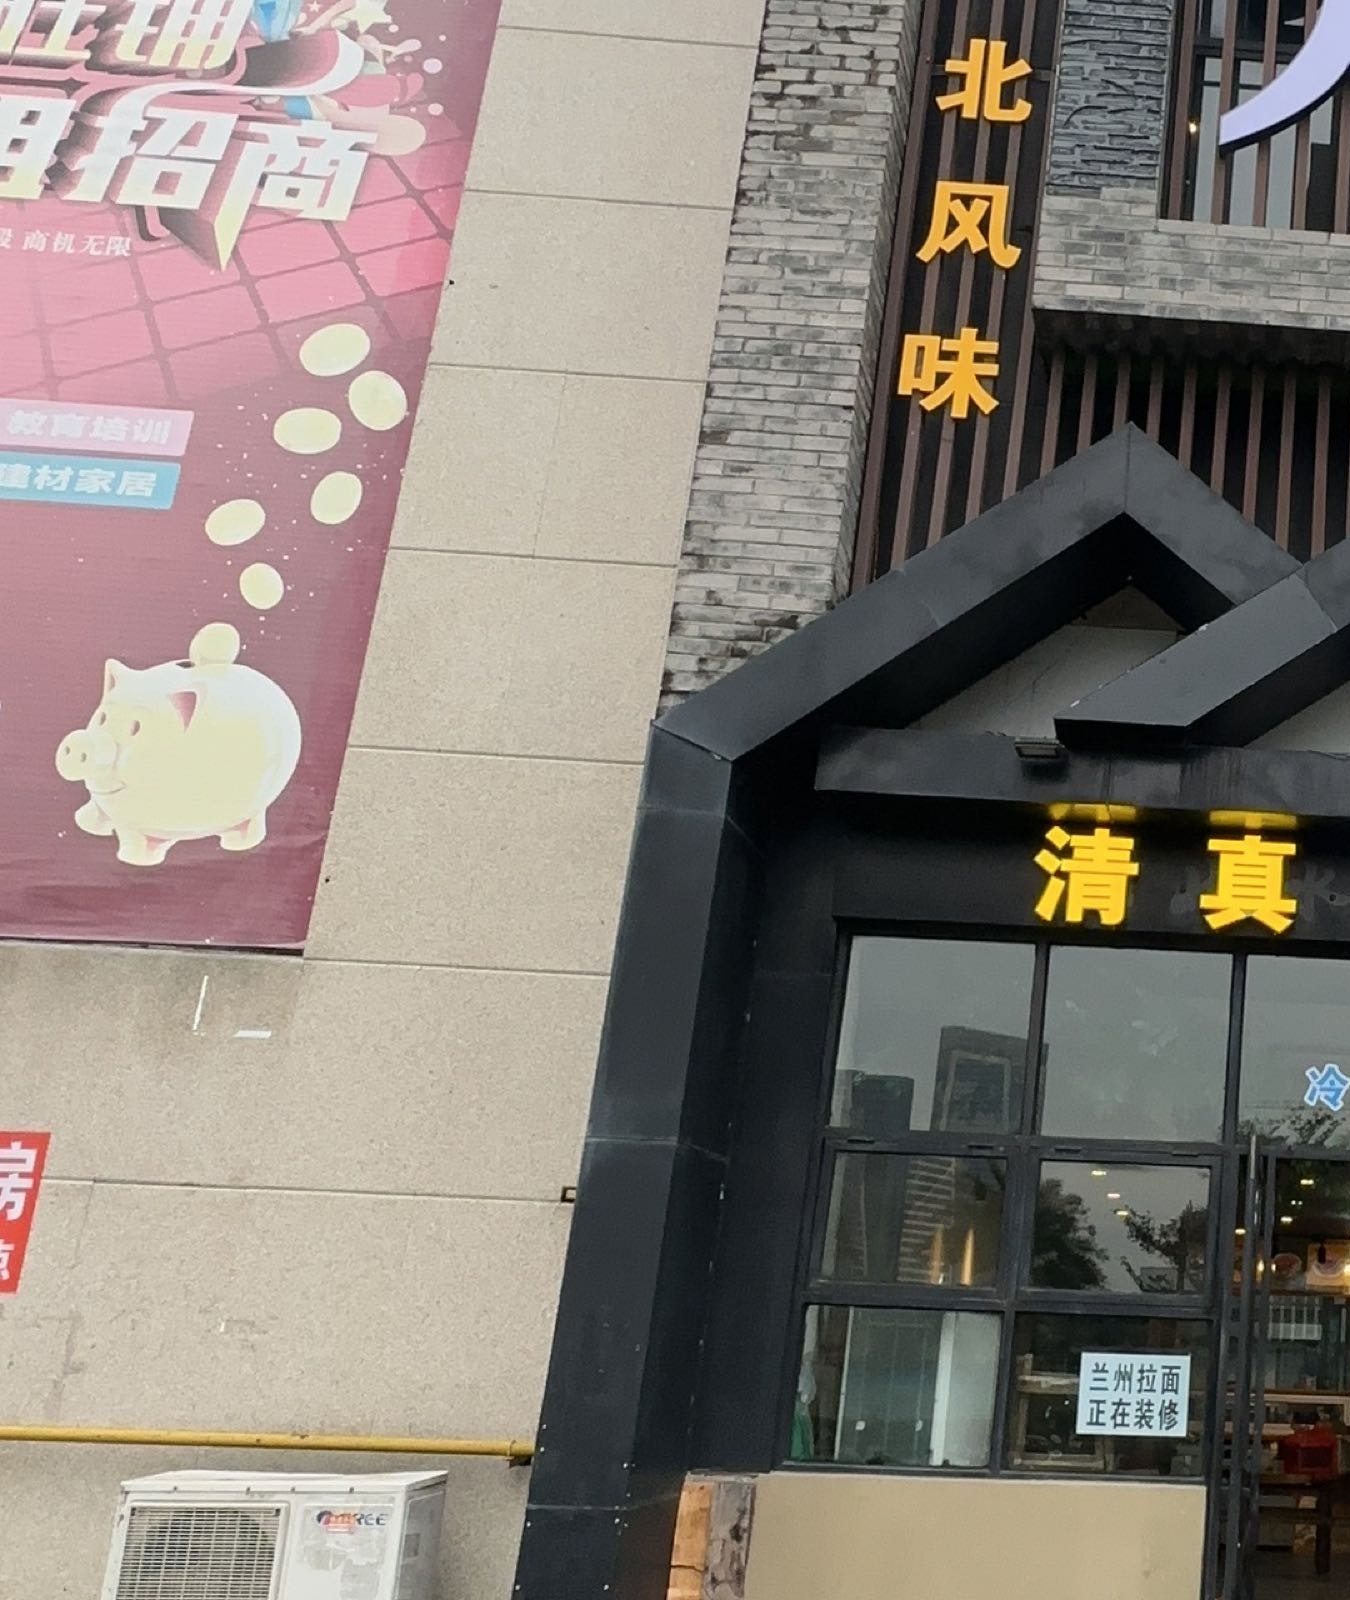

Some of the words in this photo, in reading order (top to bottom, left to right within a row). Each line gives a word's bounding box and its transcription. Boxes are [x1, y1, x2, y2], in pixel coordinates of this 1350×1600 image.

[8, 410, 172, 445] 教育培训
[0, 463, 157, 497] 建材家居
[1089, 1362, 1181, 1395] 兰州拉面
[1086, 1398, 1179, 1430] 正在装修
